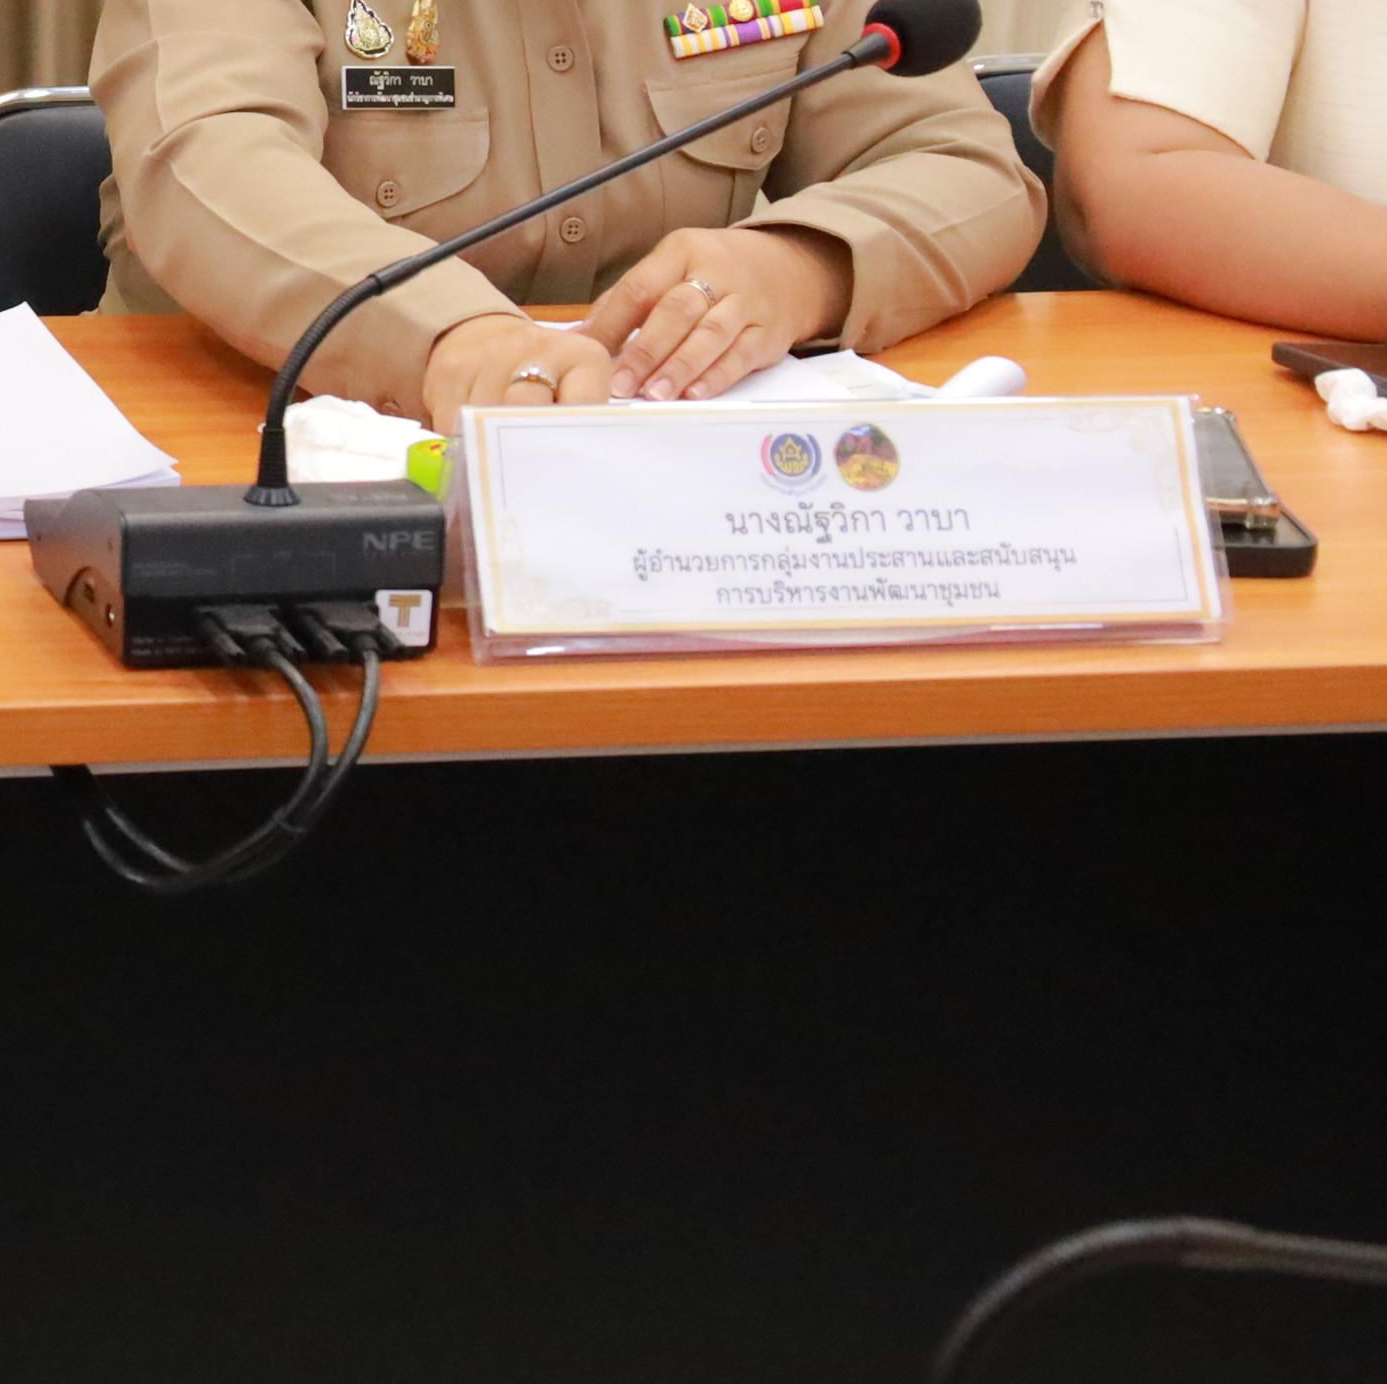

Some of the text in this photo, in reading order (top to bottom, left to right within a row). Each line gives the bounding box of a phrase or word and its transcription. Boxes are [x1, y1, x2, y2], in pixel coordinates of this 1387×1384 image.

[725, 502, 970, 544] นางณัฐวิกา วาบา
[363, 531, 435, 551] NPE
[716, 577, 1001, 607] การบริหารงานพัฒนาชุมชน
